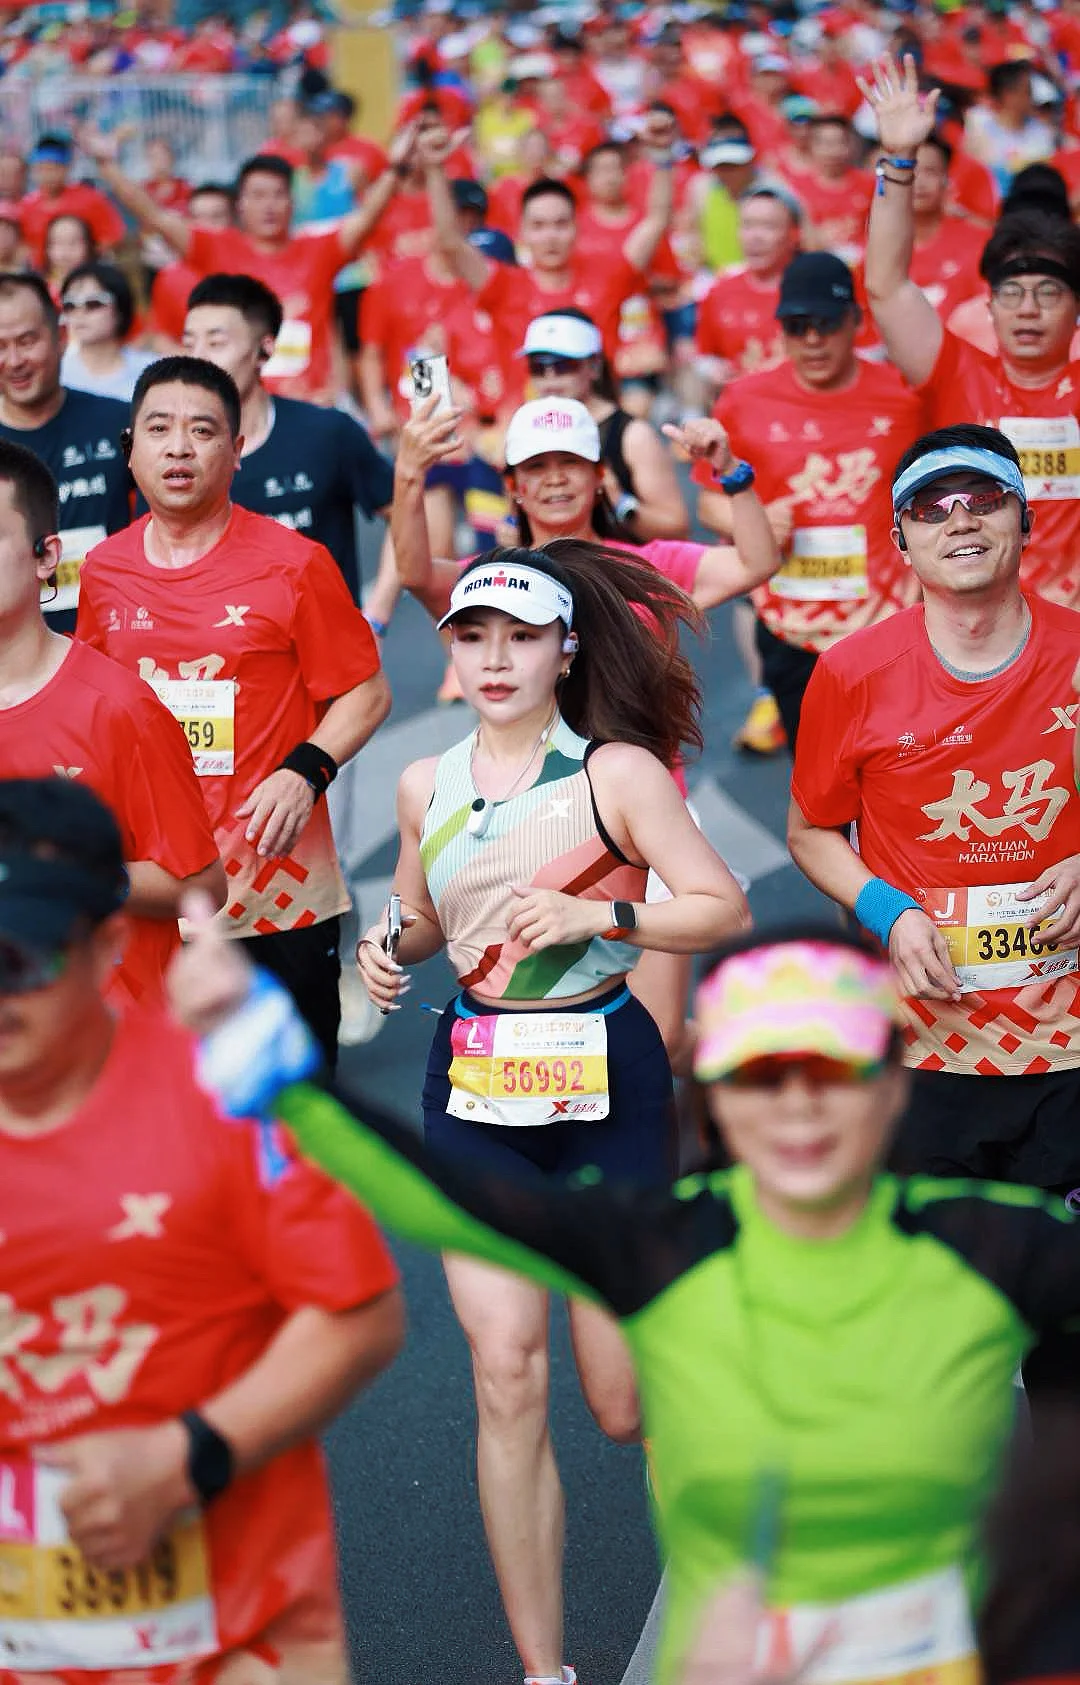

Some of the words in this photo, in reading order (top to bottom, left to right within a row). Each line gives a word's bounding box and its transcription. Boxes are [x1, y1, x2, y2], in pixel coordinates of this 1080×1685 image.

[463, 570, 531, 595] IRONMAN
[177, 721, 215, 748] 59
[958, 849, 1035, 864] MARATHON
[968, 839, 1028, 853] TAIYUAN
[933, 892, 956, 919] J
[466, 1022, 484, 1049] L
[503, 1060, 585, 1094] 56992
